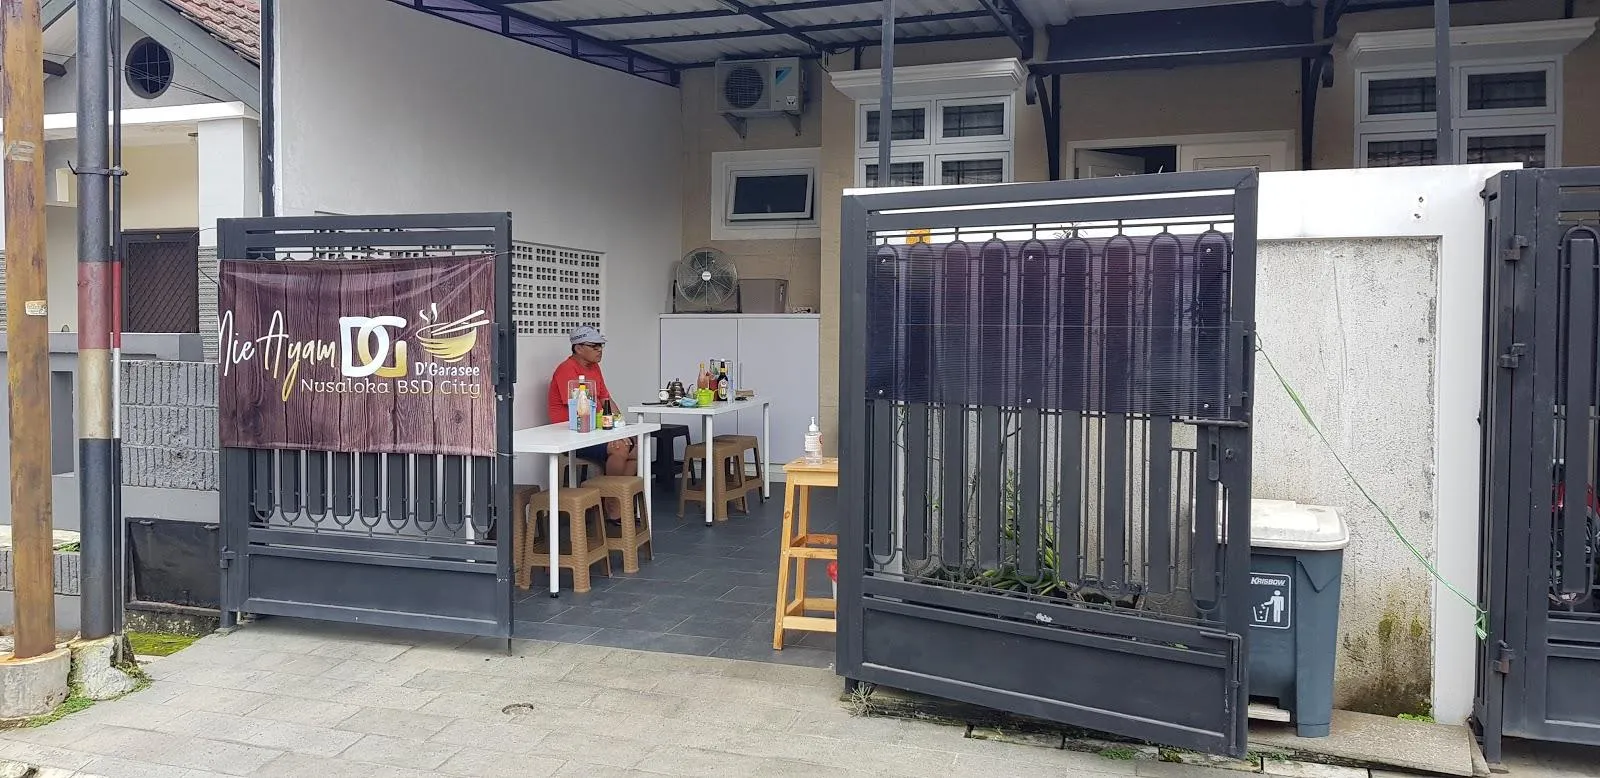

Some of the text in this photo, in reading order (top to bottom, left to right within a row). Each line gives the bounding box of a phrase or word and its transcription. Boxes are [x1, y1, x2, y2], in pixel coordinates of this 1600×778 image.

[256, 310, 336, 402] Ayam
[339, 315, 407, 378] DG
[415, 361, 480, 377] D'Garasee
[301, 378, 481, 399] Nusaloka BSD City
[1250, 577, 1286, 586] KRISBOW
